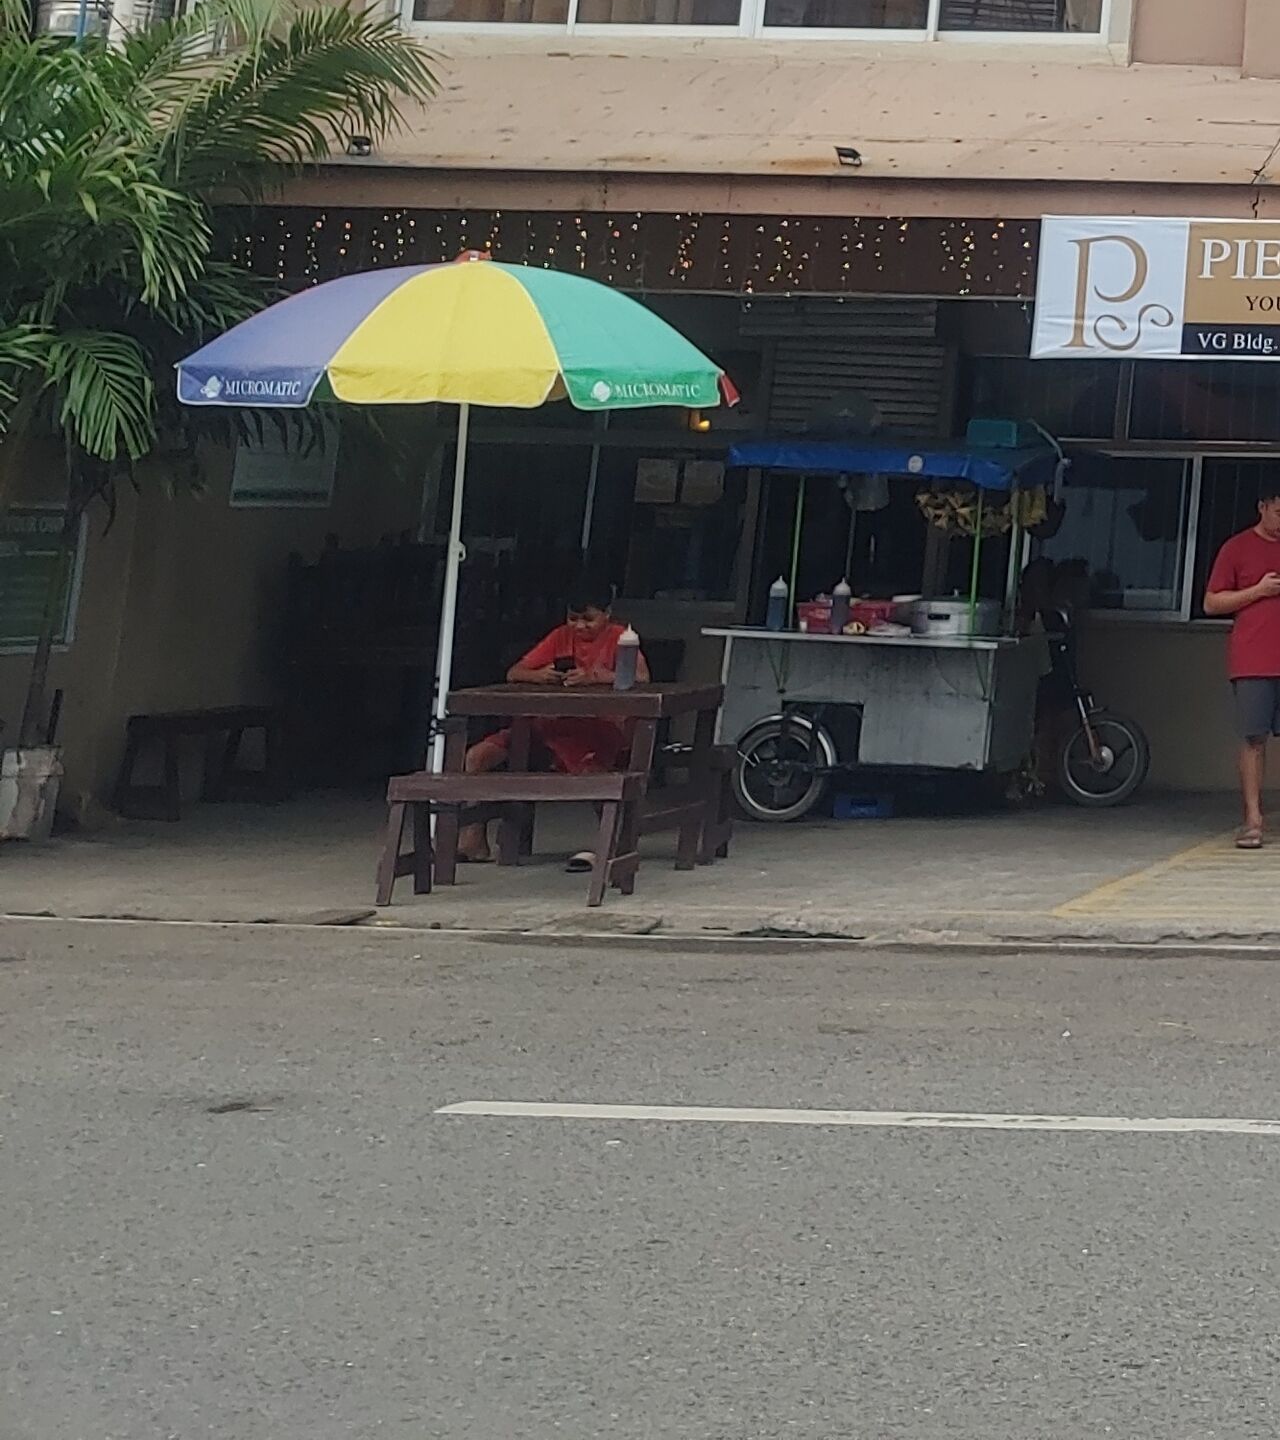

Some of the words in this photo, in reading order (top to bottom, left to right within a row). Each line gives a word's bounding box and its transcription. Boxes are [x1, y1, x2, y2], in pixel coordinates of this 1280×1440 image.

[1197, 332, 1228, 350] VG
[1232, 332, 1279, 355] Bldg.
[225, 378, 301, 396] MICROMATIC
[615, 382, 700, 399] MICROMATIC
